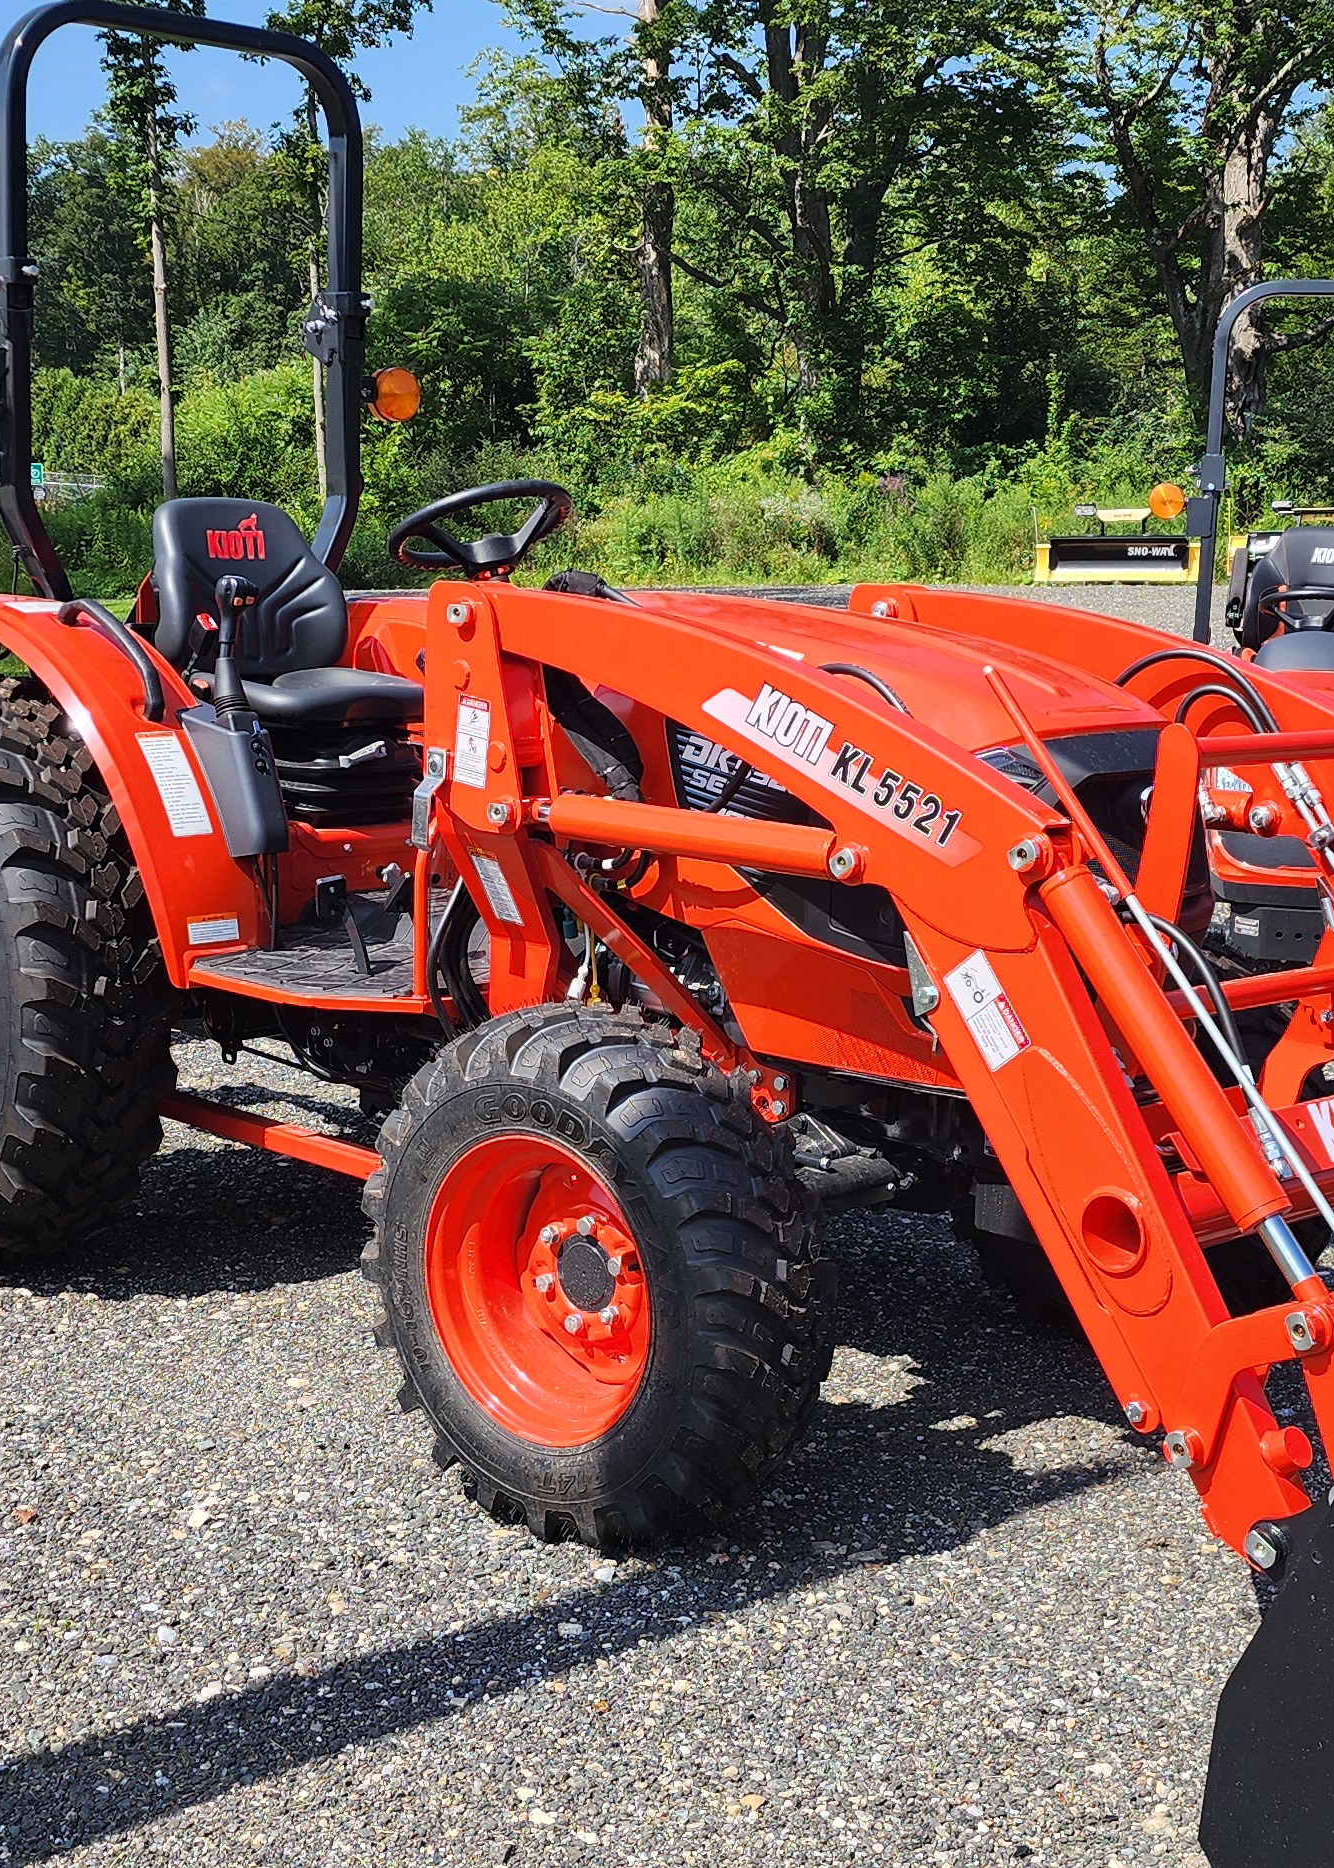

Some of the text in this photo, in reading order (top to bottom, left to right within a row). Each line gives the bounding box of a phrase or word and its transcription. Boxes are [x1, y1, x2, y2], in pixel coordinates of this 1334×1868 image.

[206, 529, 266, 560] KIOTI
[745, 682, 836, 766] KIOTI
[1002, 1007, 1026, 1045] DANGER
